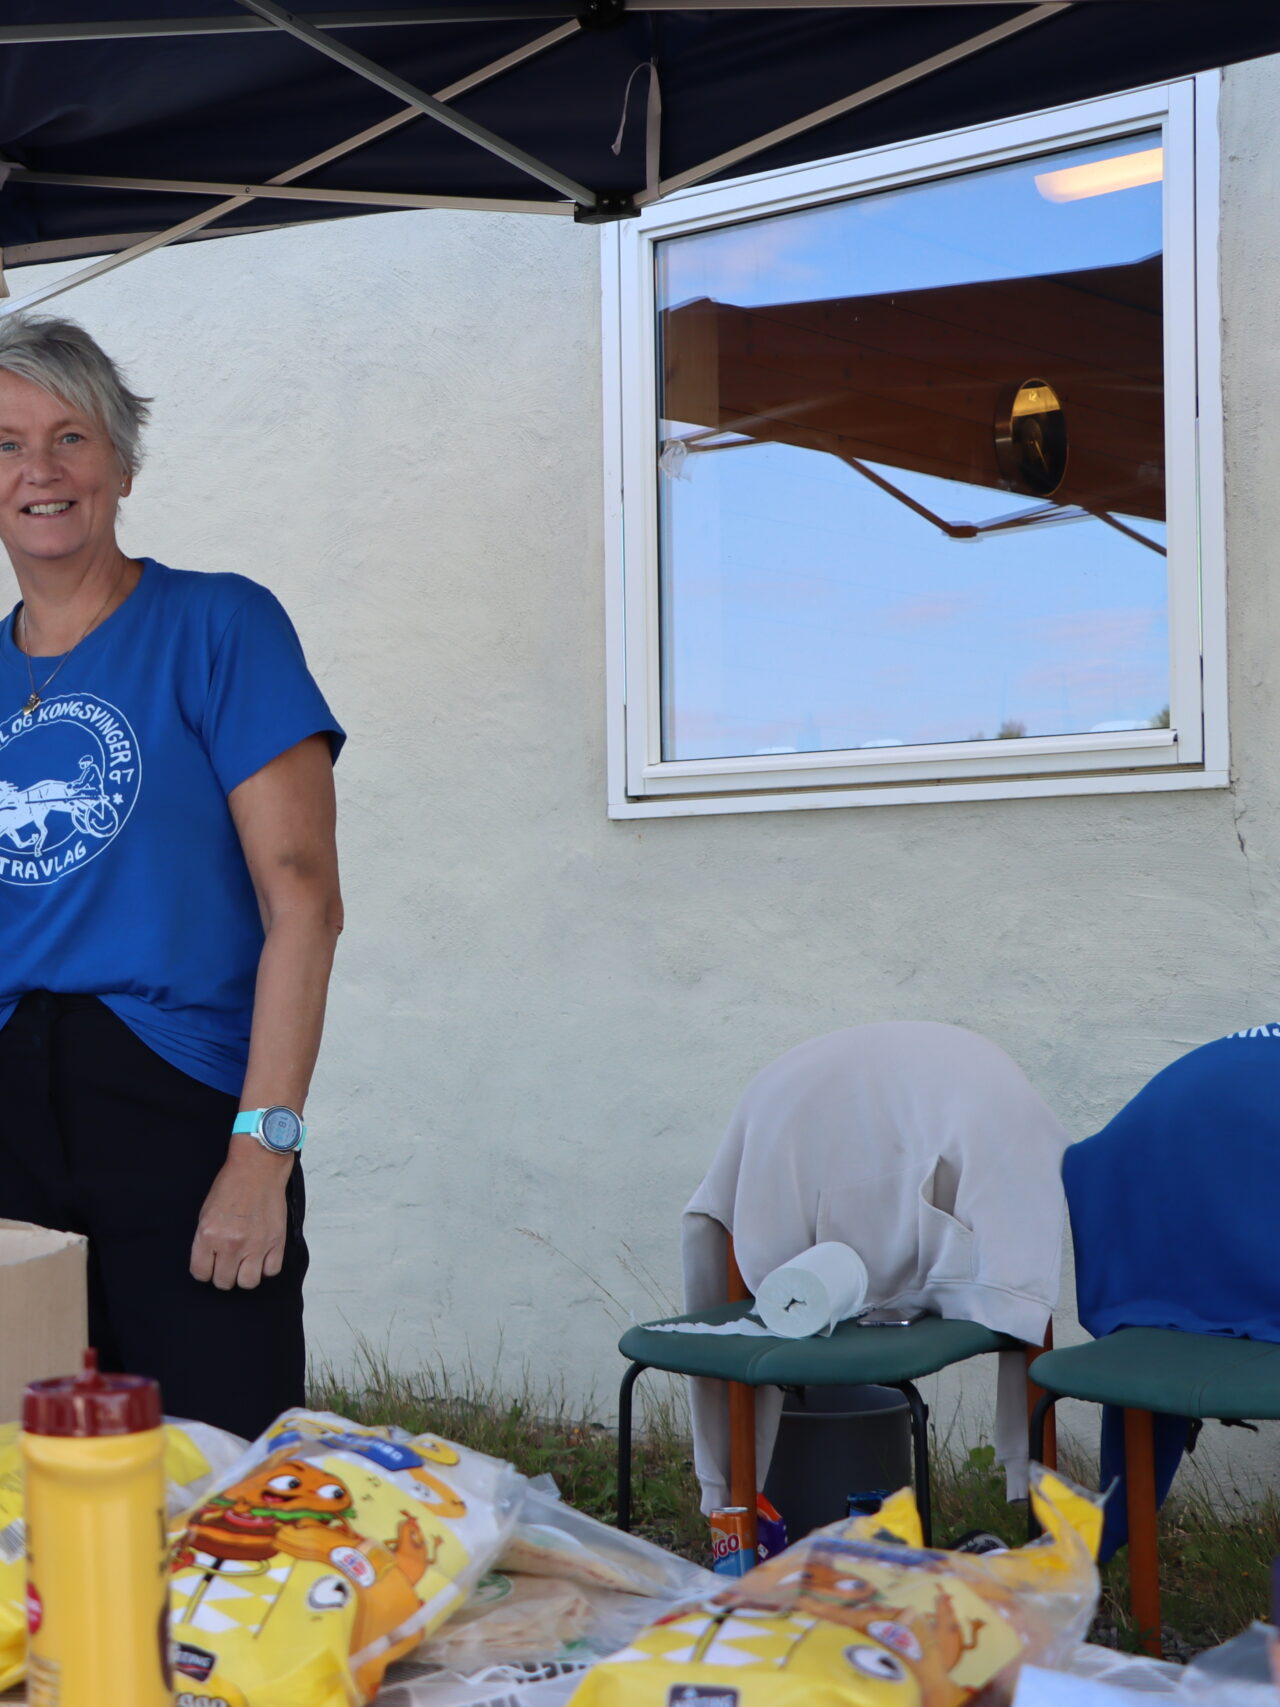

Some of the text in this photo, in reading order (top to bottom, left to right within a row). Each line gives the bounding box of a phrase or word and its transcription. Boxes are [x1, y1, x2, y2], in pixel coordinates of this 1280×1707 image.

[11, 713, 33, 734] OG
[37, 700, 132, 764] KONGSVINGER
[109, 768, 135, 784] 97
